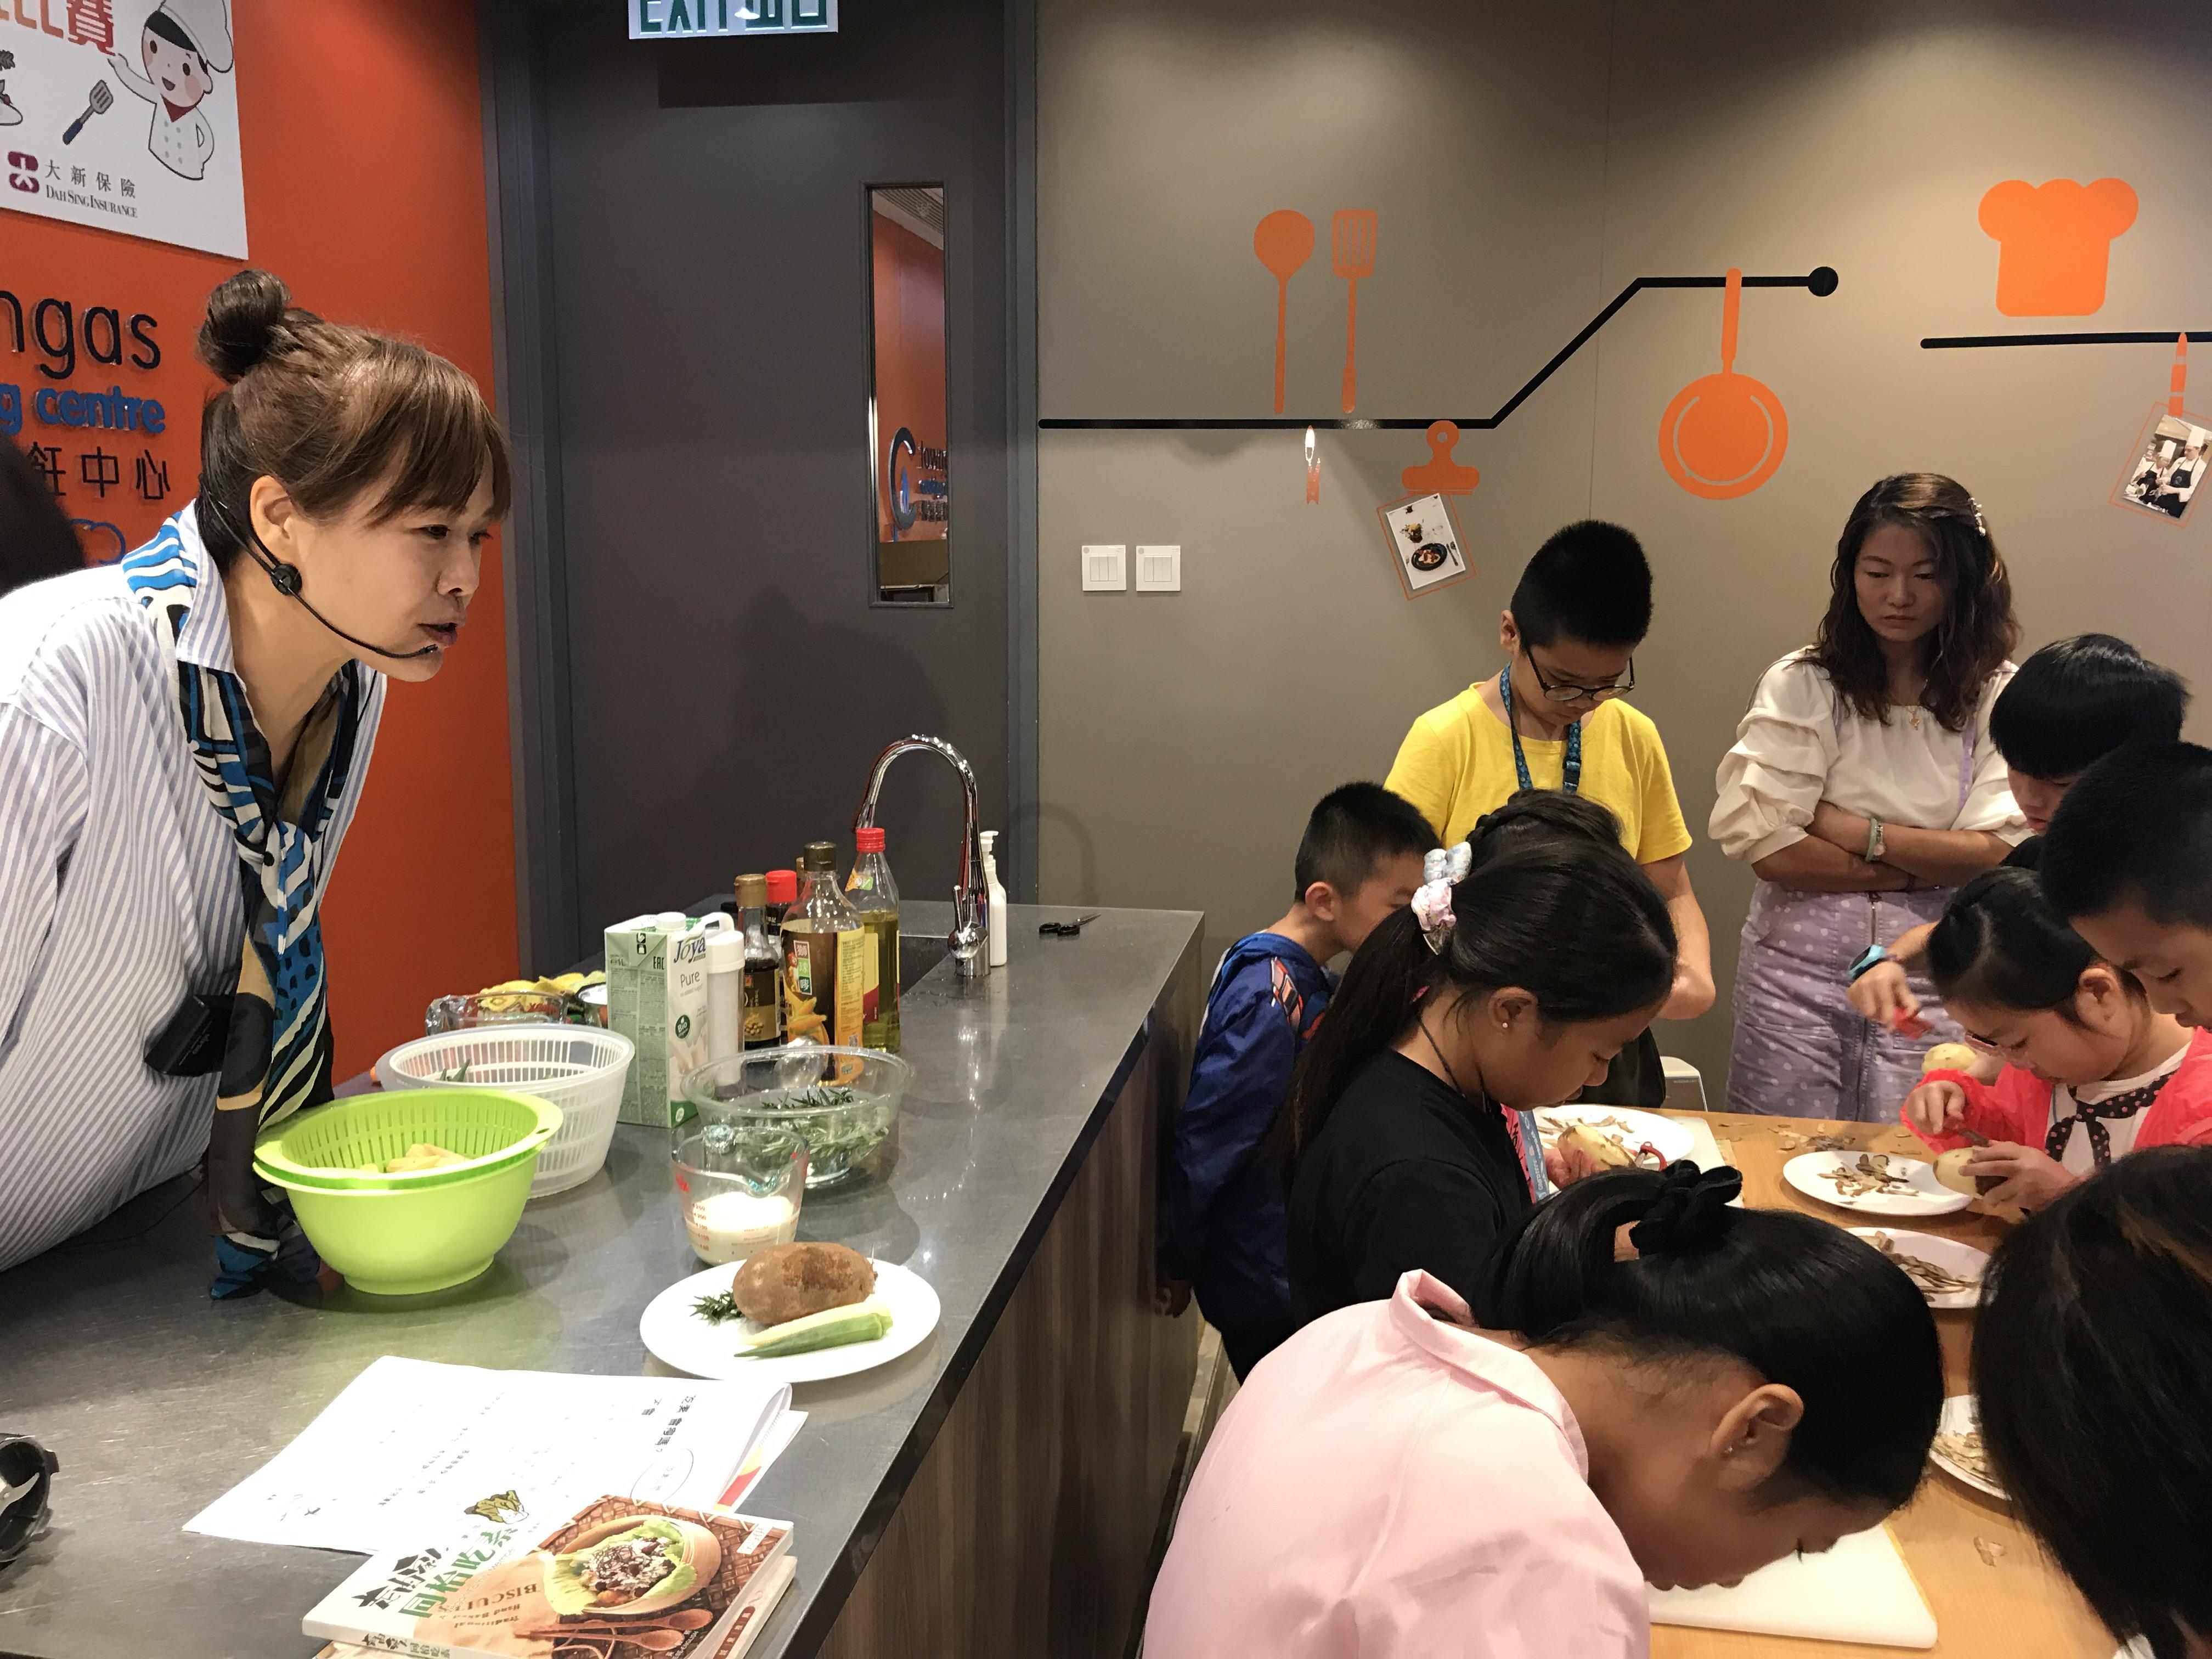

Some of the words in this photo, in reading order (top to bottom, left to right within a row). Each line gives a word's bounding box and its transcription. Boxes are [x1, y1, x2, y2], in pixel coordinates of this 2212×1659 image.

[44, 159, 136, 199] 大新保險
[46, 184, 66, 202] DAH
[67, 190, 89, 207] SING
[91, 195, 138, 218] INSURANCE
[35, 385, 166, 434] centre
[673, 937, 706, 963] Joya
[680, 971, 700, 988] Pure
